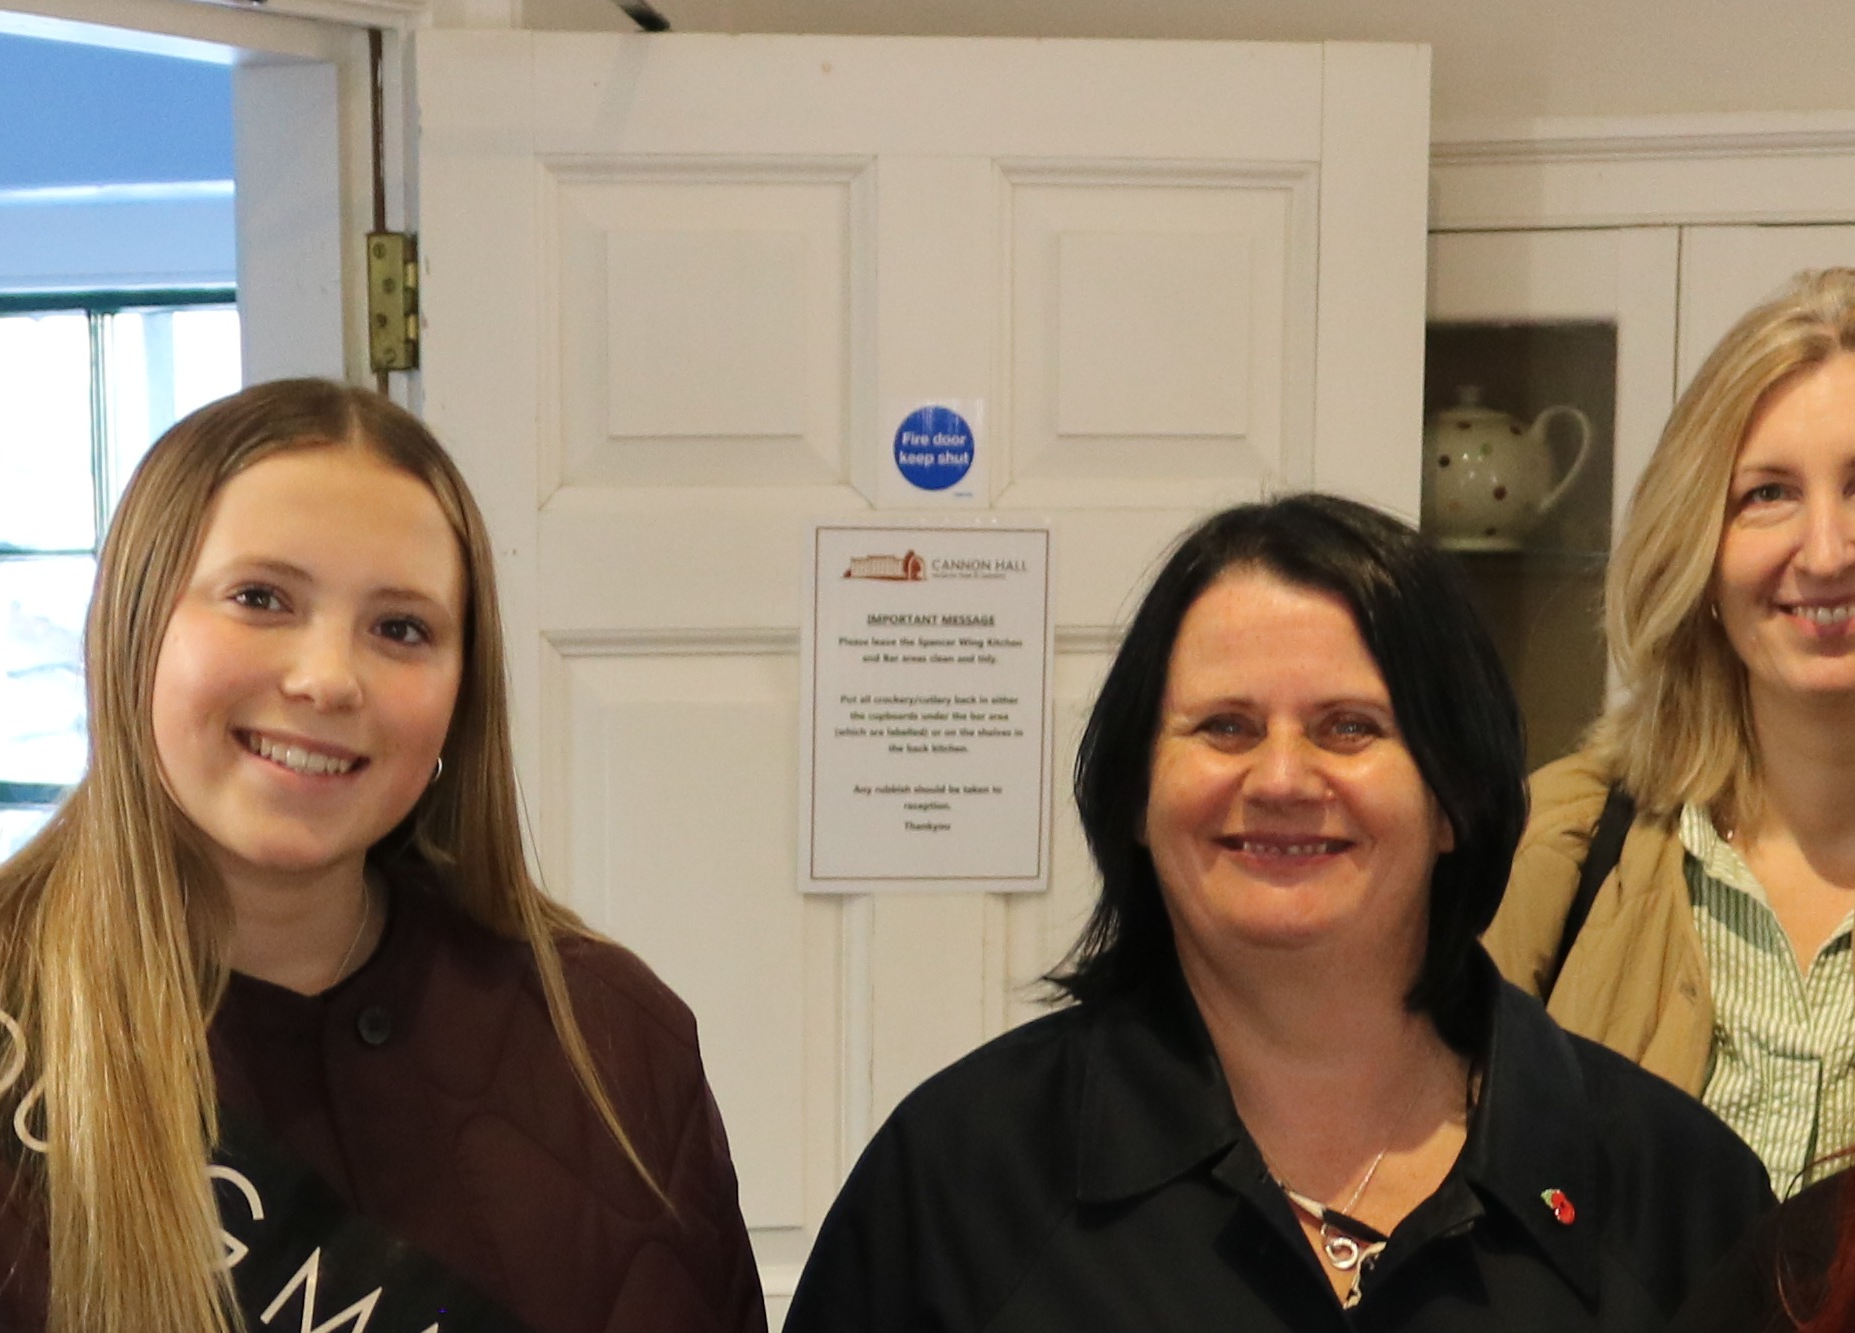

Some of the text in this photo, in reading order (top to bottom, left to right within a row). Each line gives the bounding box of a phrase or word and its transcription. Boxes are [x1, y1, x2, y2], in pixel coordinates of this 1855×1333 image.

[902, 431, 966, 446] Fire door
[899, 450, 969, 468] keep shut
[931, 558, 1027, 572] CANNON HALL
[866, 614, 995, 626] IMPORTANT MESSAGE
[899, 636, 915, 646] the
